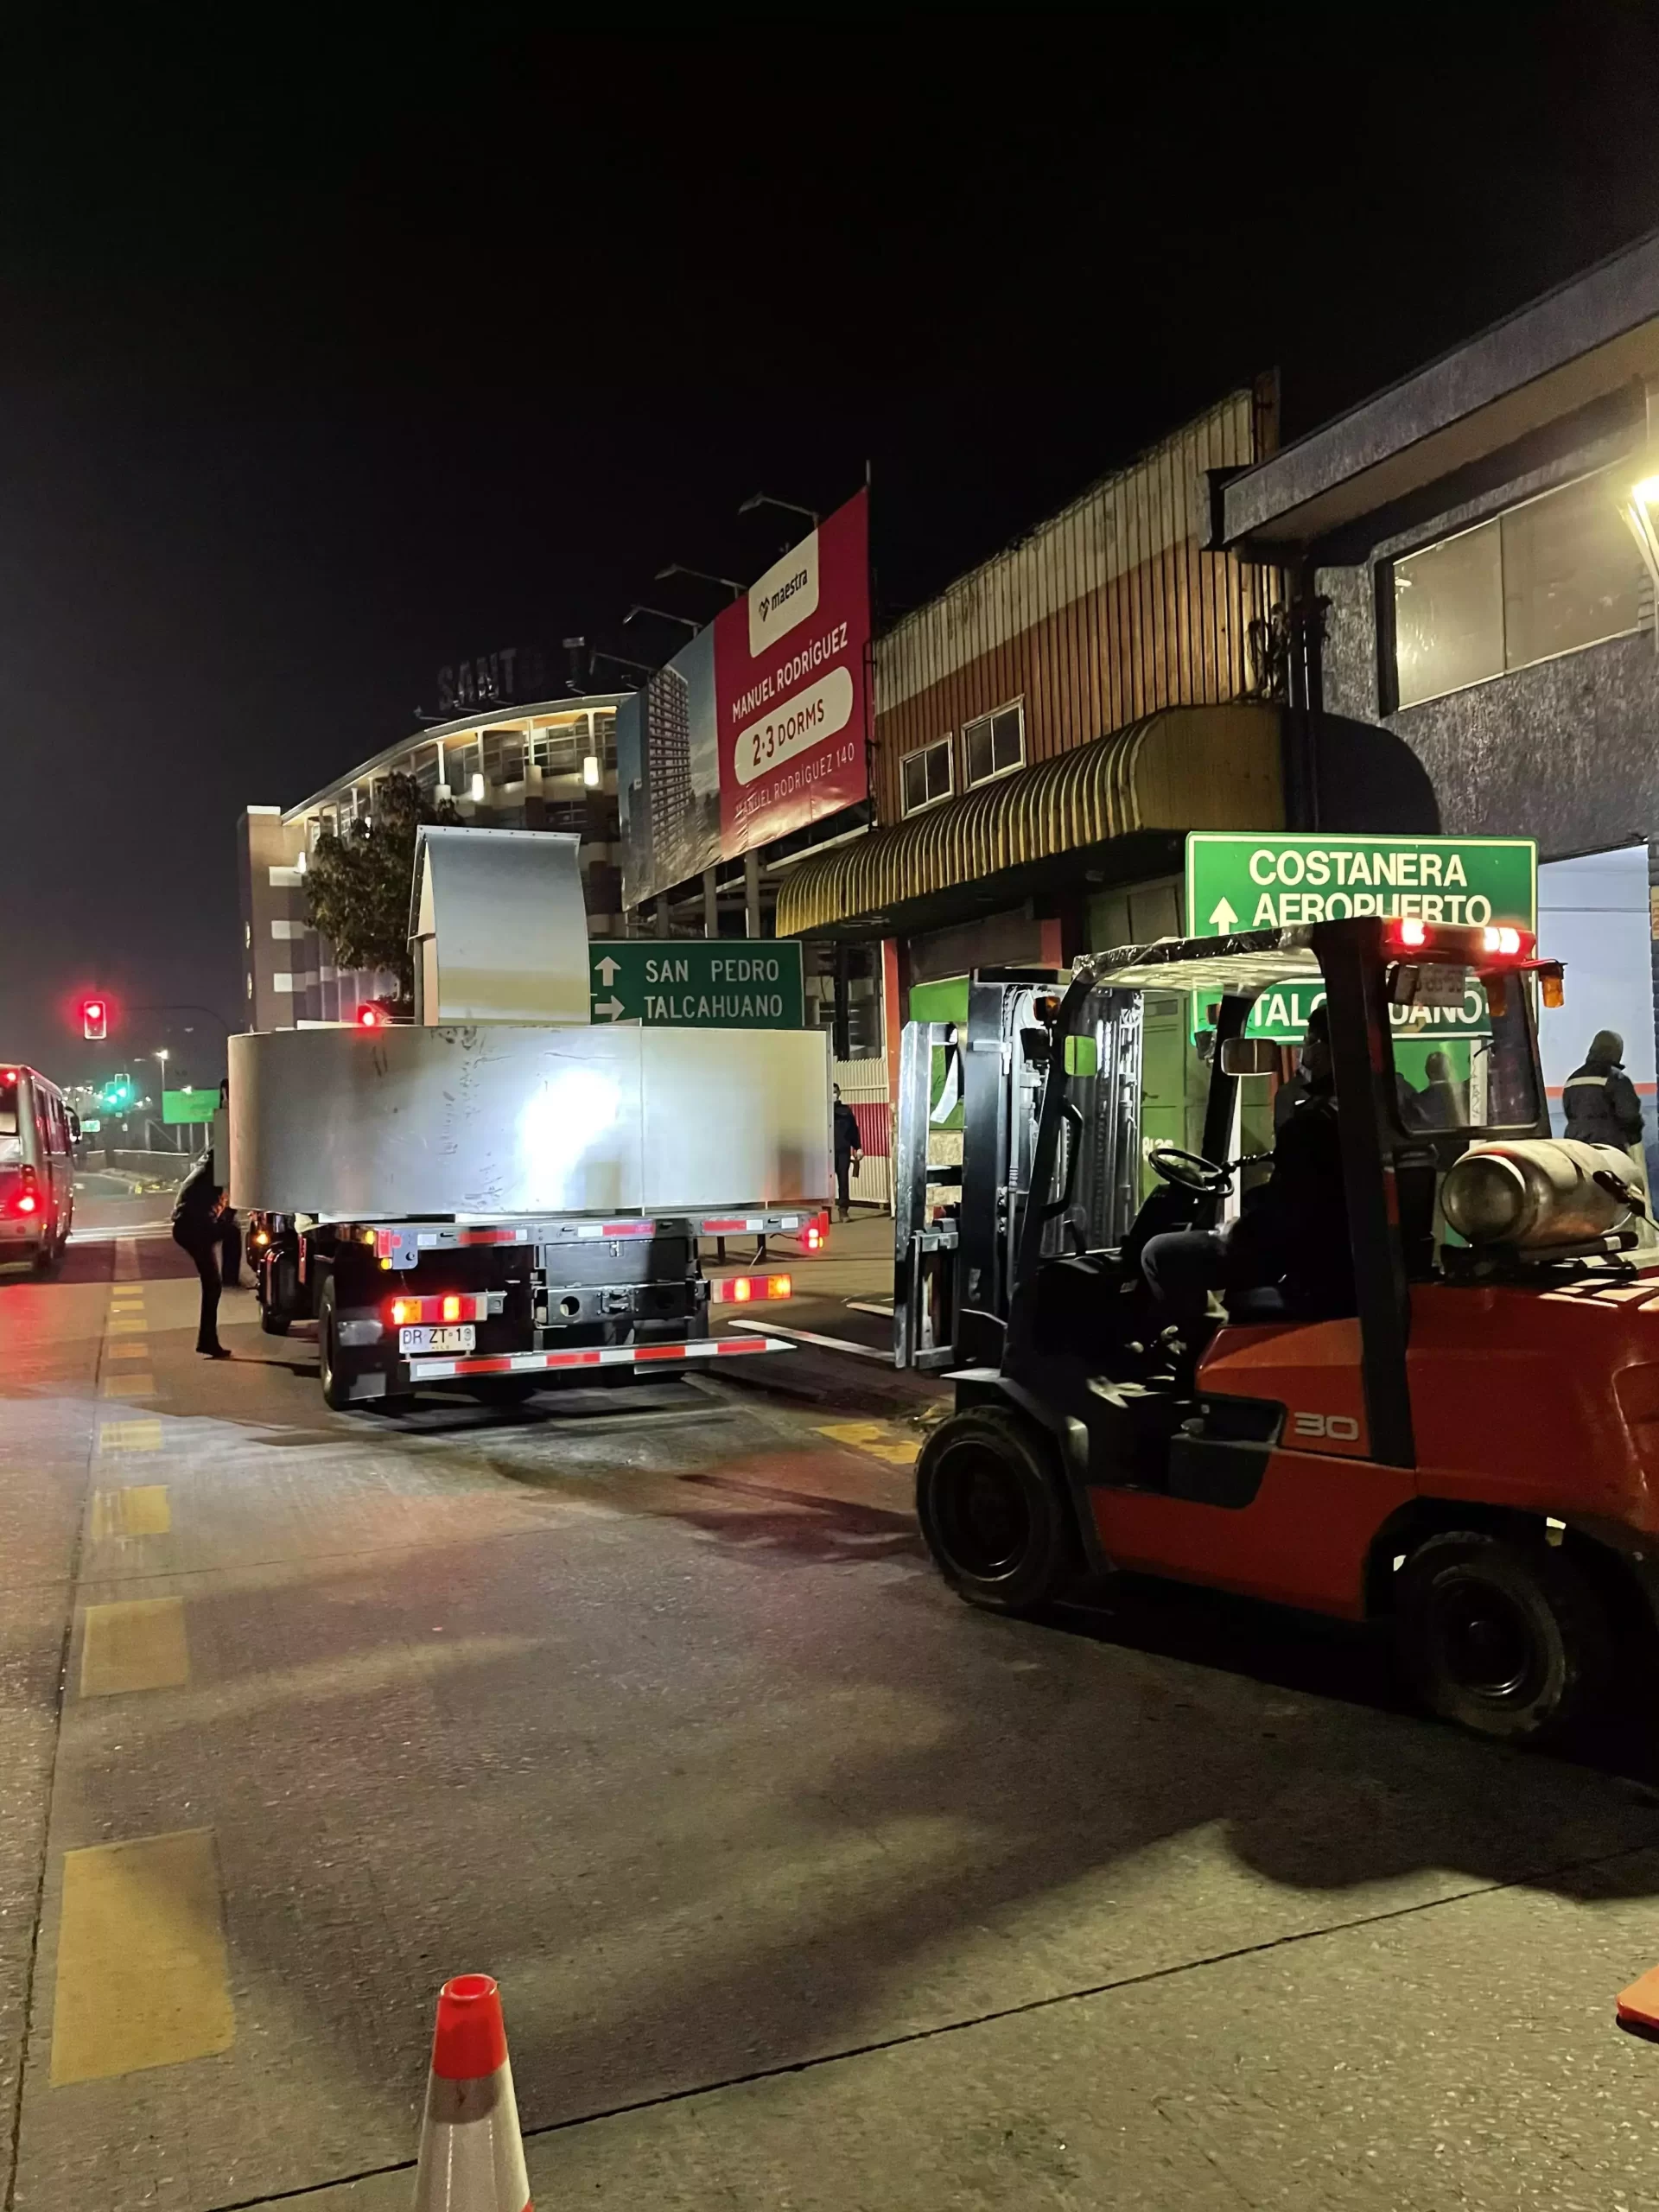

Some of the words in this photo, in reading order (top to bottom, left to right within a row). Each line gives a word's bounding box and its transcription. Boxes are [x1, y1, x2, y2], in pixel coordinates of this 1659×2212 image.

[772, 569, 809, 611] maestra
[733, 676, 775, 723] MANUEL
[777, 621, 849, 691] RODRÍGUEZ
[779, 699, 824, 747] DORMS
[774, 753, 833, 800] RODRÍGUEZ
[836, 742, 855, 767] 140
[1249, 849, 1468, 887] COSTANERA
[645, 959, 690, 983] SAN
[710, 959, 779, 982] PEDRO
[644, 995, 783, 1019] TALCAHUANO
[1294, 1412, 1358, 1440] 30
